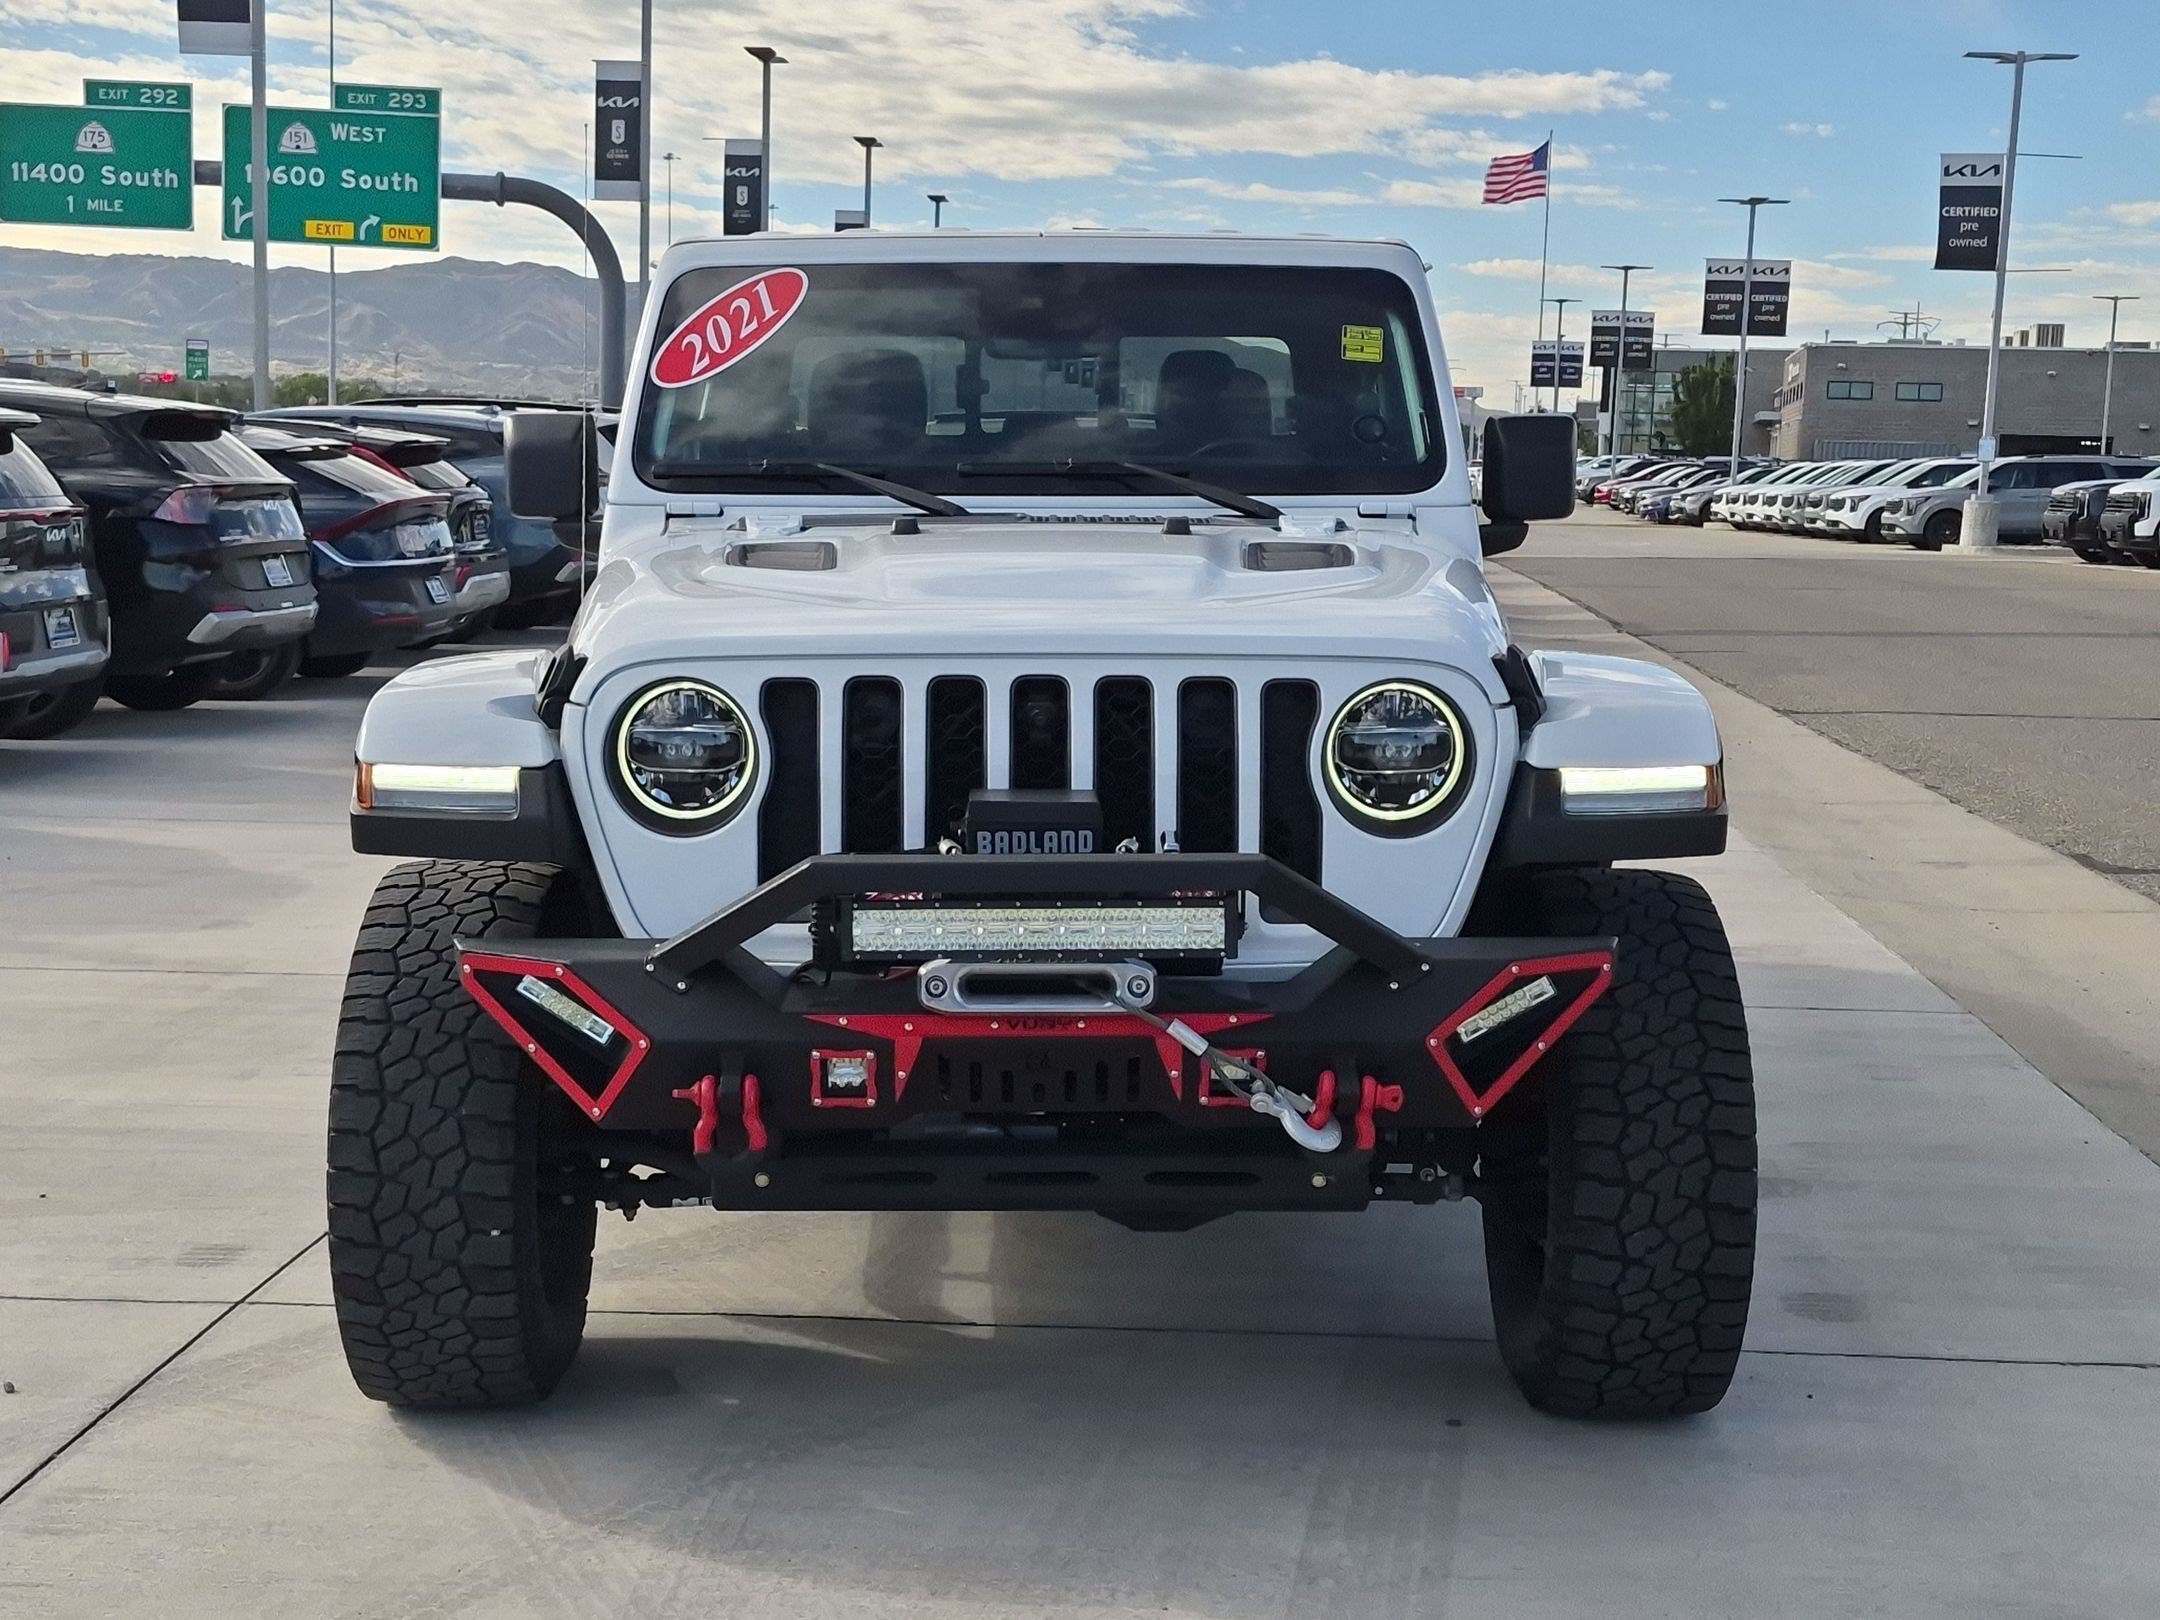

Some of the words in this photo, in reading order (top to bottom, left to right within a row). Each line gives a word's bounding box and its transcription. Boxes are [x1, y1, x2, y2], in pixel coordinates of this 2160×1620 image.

[99, 88, 129, 99] EXIT
[140, 88, 178, 104] 292
[347, 93, 377, 104] EXIT
[388, 93, 427, 108] 293
[597, 96, 640, 108] KIA
[84, 131, 105, 143] 175
[289, 131, 307, 143] 151
[330, 122, 386, 143] WEST
[11, 161, 85, 184] 11400
[101, 165, 179, 188] South
[725, 167, 760, 177] KIA
[1943, 164, 2000, 177] KIA
[341, 168, 419, 192] South
[66, 195, 74, 213] 1
[87, 199, 124, 212] MILE
[1941, 206, 1999, 217] CERTIFIED
[316, 224, 344, 236] EXIT
[388, 229, 425, 240] ONLY
[1960, 221, 1979, 233] pre
[1948, 236, 1988, 248] owned
[1707, 266, 1744, 274] KIA
[1753, 267, 1789, 276] KIA
[681, 279, 780, 377] 2021
[976, 830, 1094, 854] BADLAND
